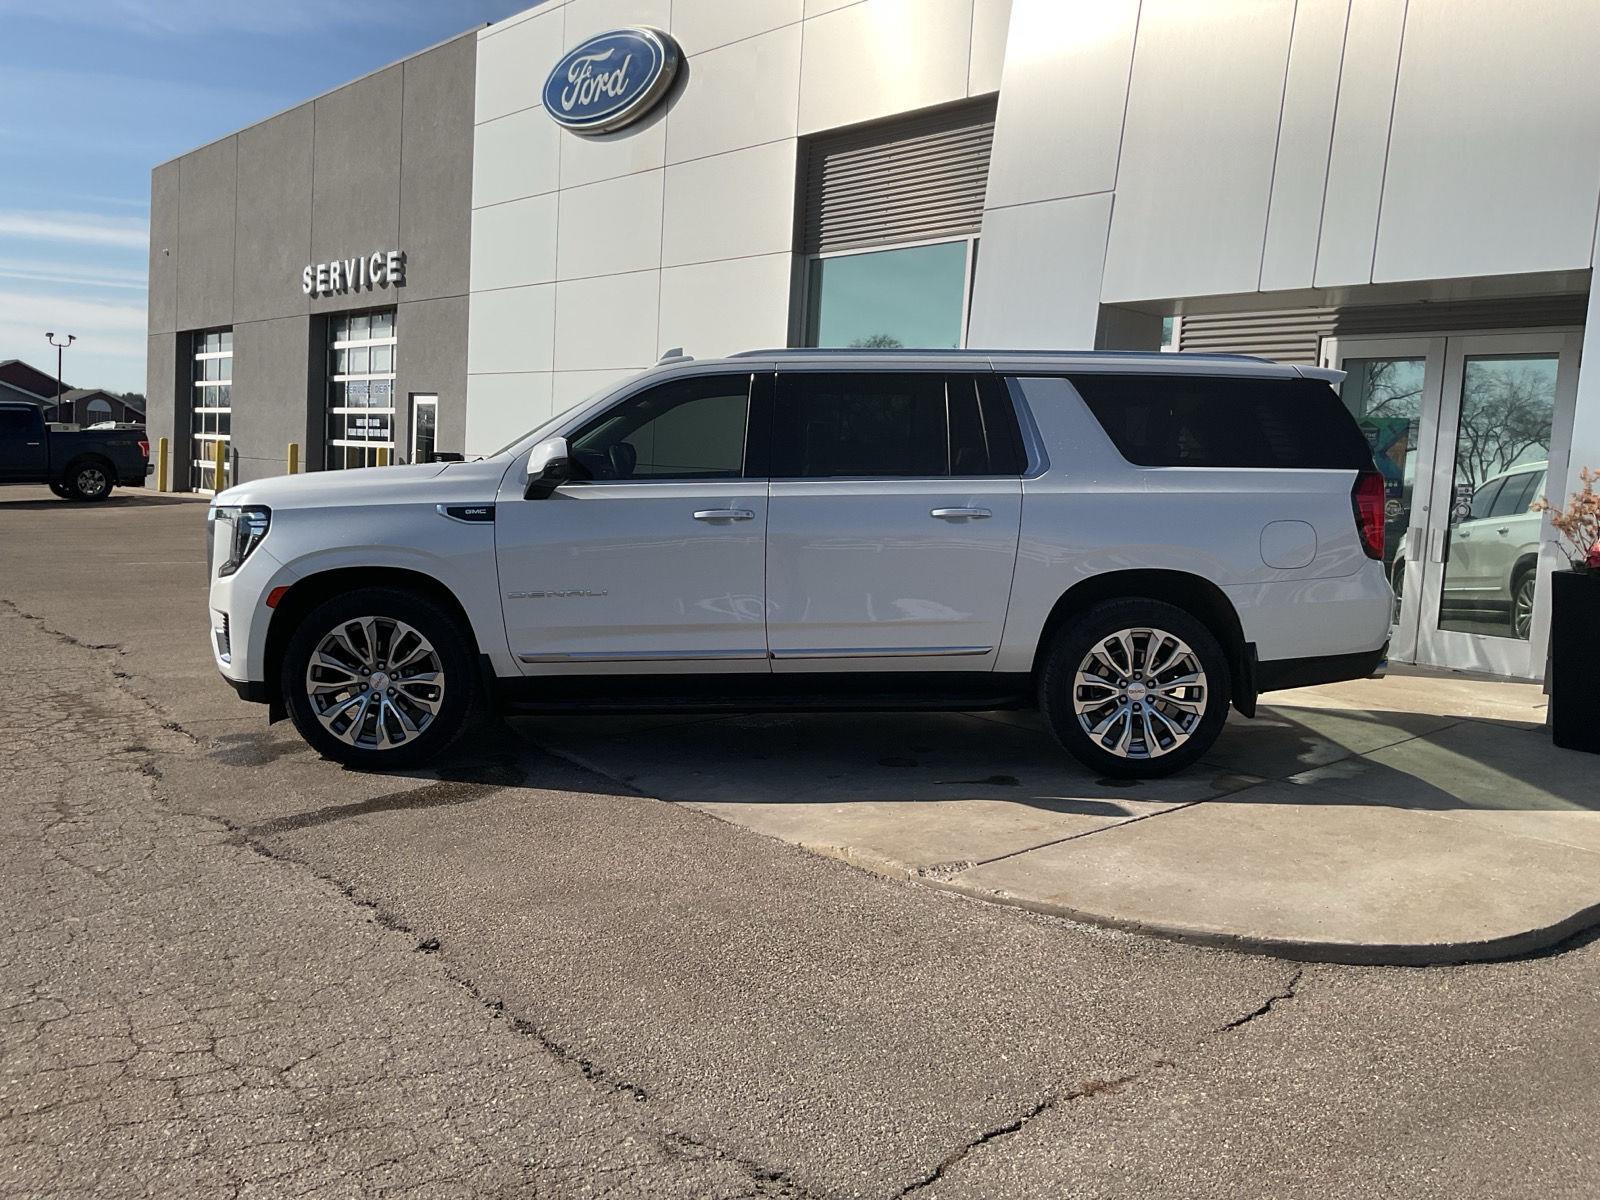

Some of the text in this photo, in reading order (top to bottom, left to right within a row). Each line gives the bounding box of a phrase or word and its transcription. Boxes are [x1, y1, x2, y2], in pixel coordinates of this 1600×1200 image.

[561, 48, 633, 111] Ford
[302, 250, 399, 294] SERVICE
[507, 589, 608, 600] DENALI
